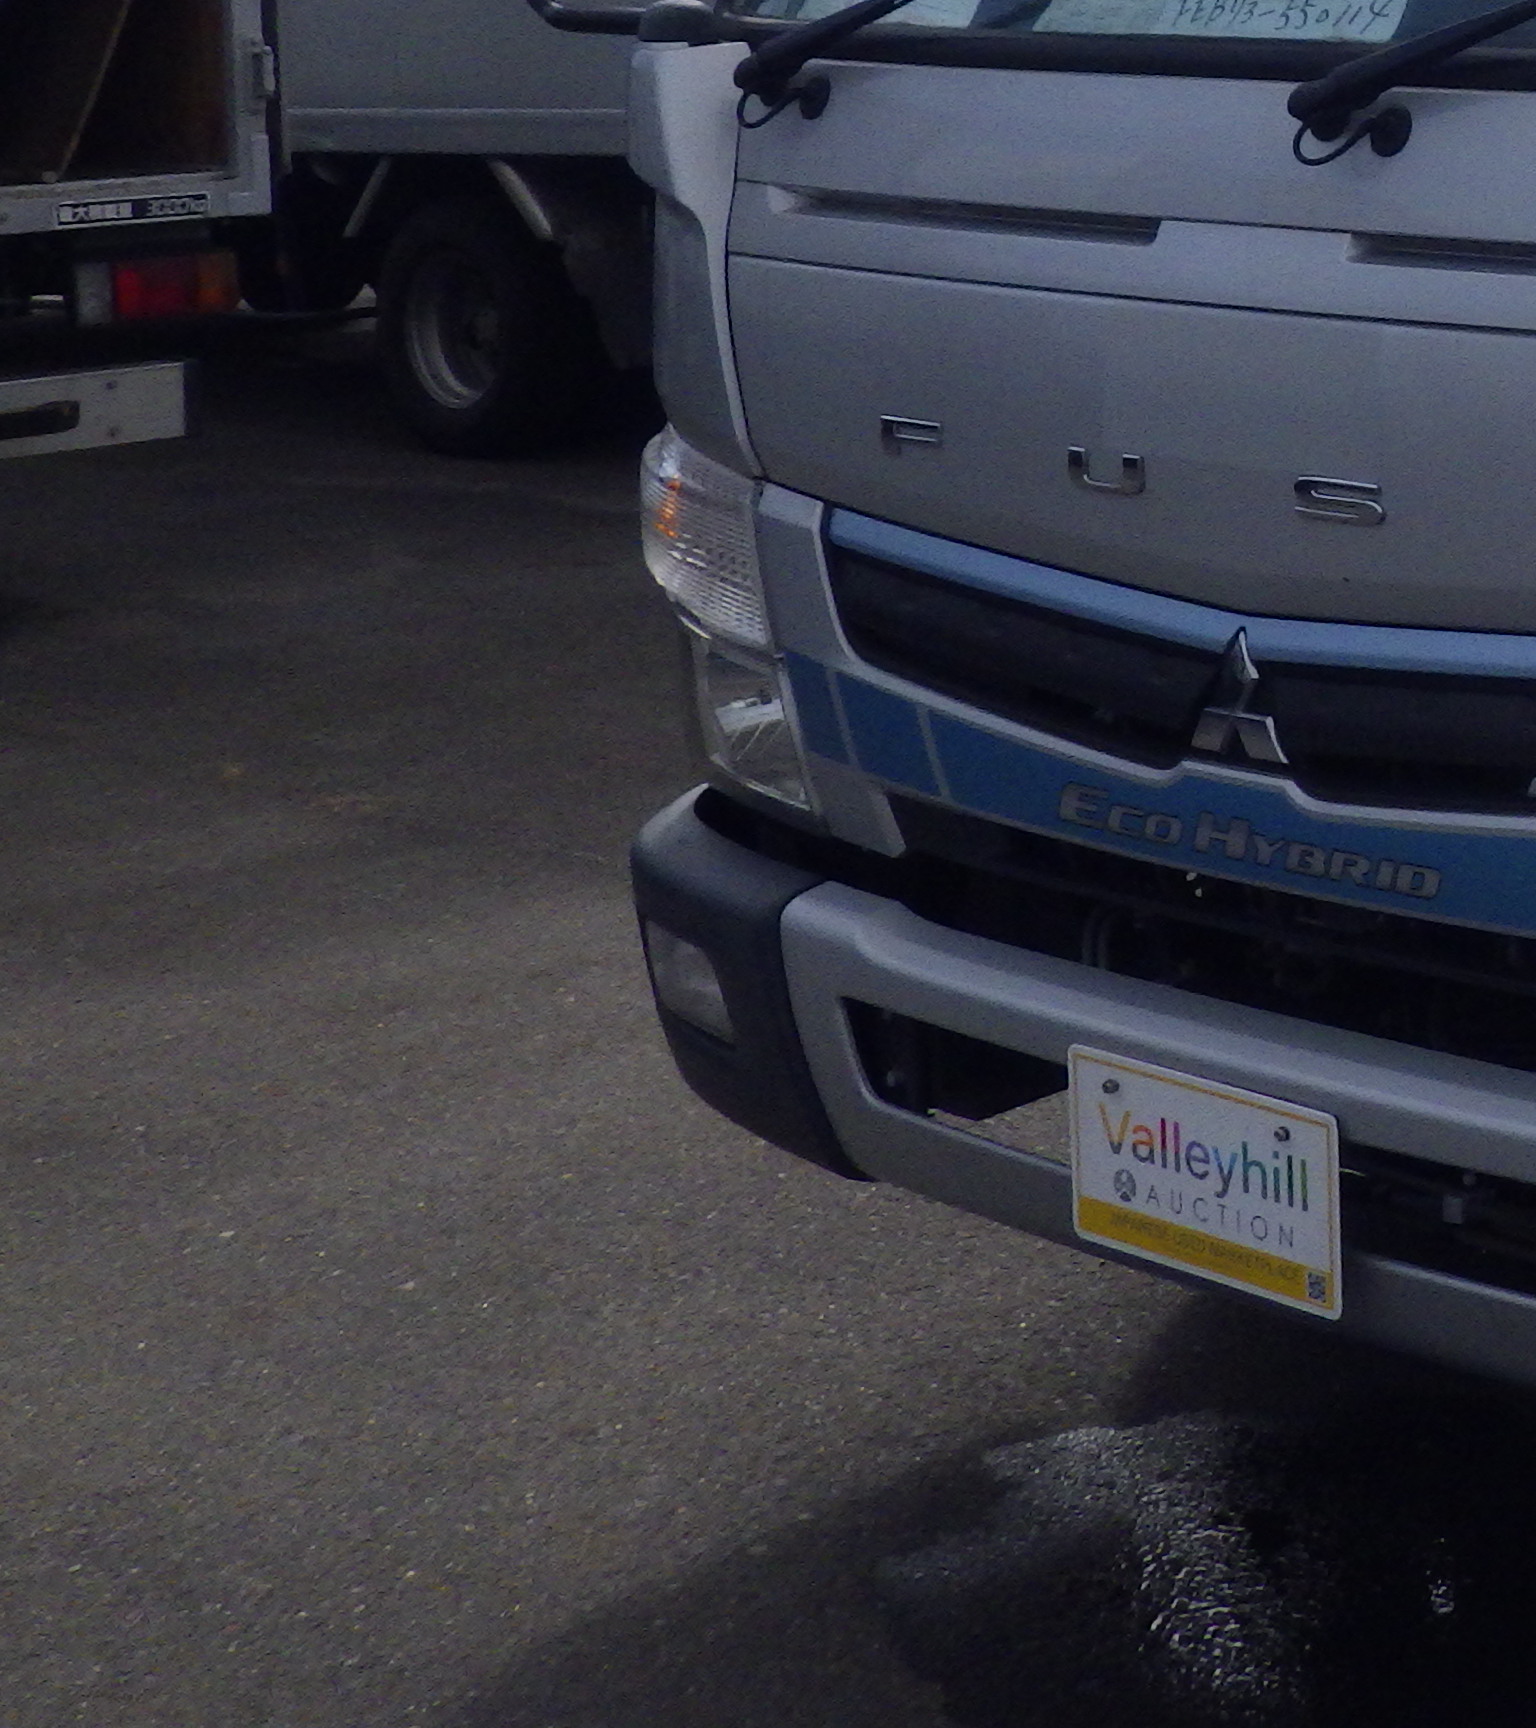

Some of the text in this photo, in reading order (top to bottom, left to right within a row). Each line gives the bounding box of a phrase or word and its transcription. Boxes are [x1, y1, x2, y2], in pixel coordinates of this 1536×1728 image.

[1193, 810, 1443, 900] HYBRID
[1097, 1101, 1309, 1212] Valleyhill
[1145, 1183, 1294, 1248] AUCTION
